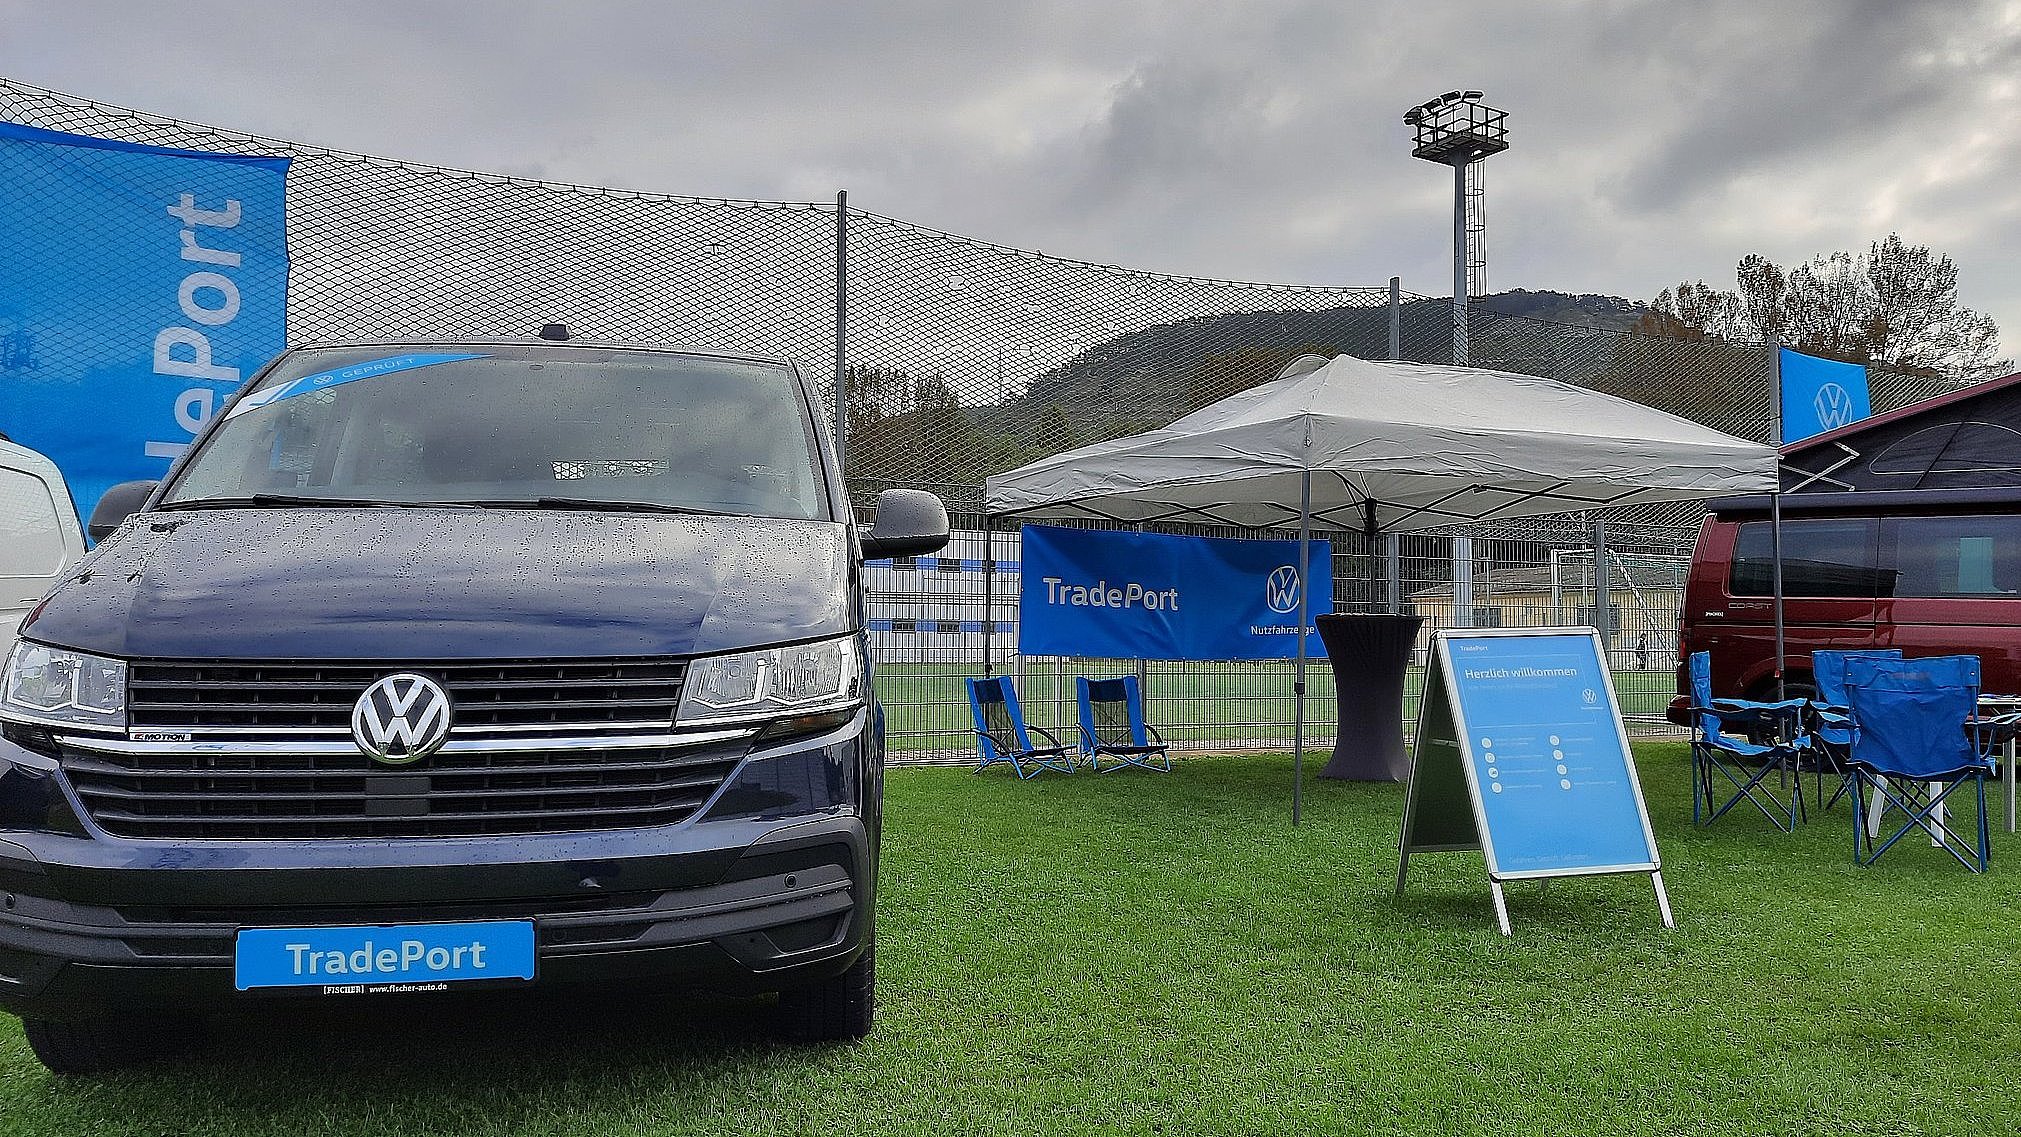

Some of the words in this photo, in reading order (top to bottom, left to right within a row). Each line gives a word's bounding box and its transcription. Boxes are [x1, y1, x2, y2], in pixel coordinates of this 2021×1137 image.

[144, 193, 242, 459] ePort
[342, 358, 416, 379] GEPRÜFT
[1042, 577, 1179, 611] TradePort
[1251, 625, 1315, 637] Nutzfahrzege
[1464, 667, 1510, 680] Herzlich
[1511, 666, 1578, 678] willkommen
[285, 940, 488, 975] TradePort
[368, 982, 448, 994] www.fischer-auto.de
